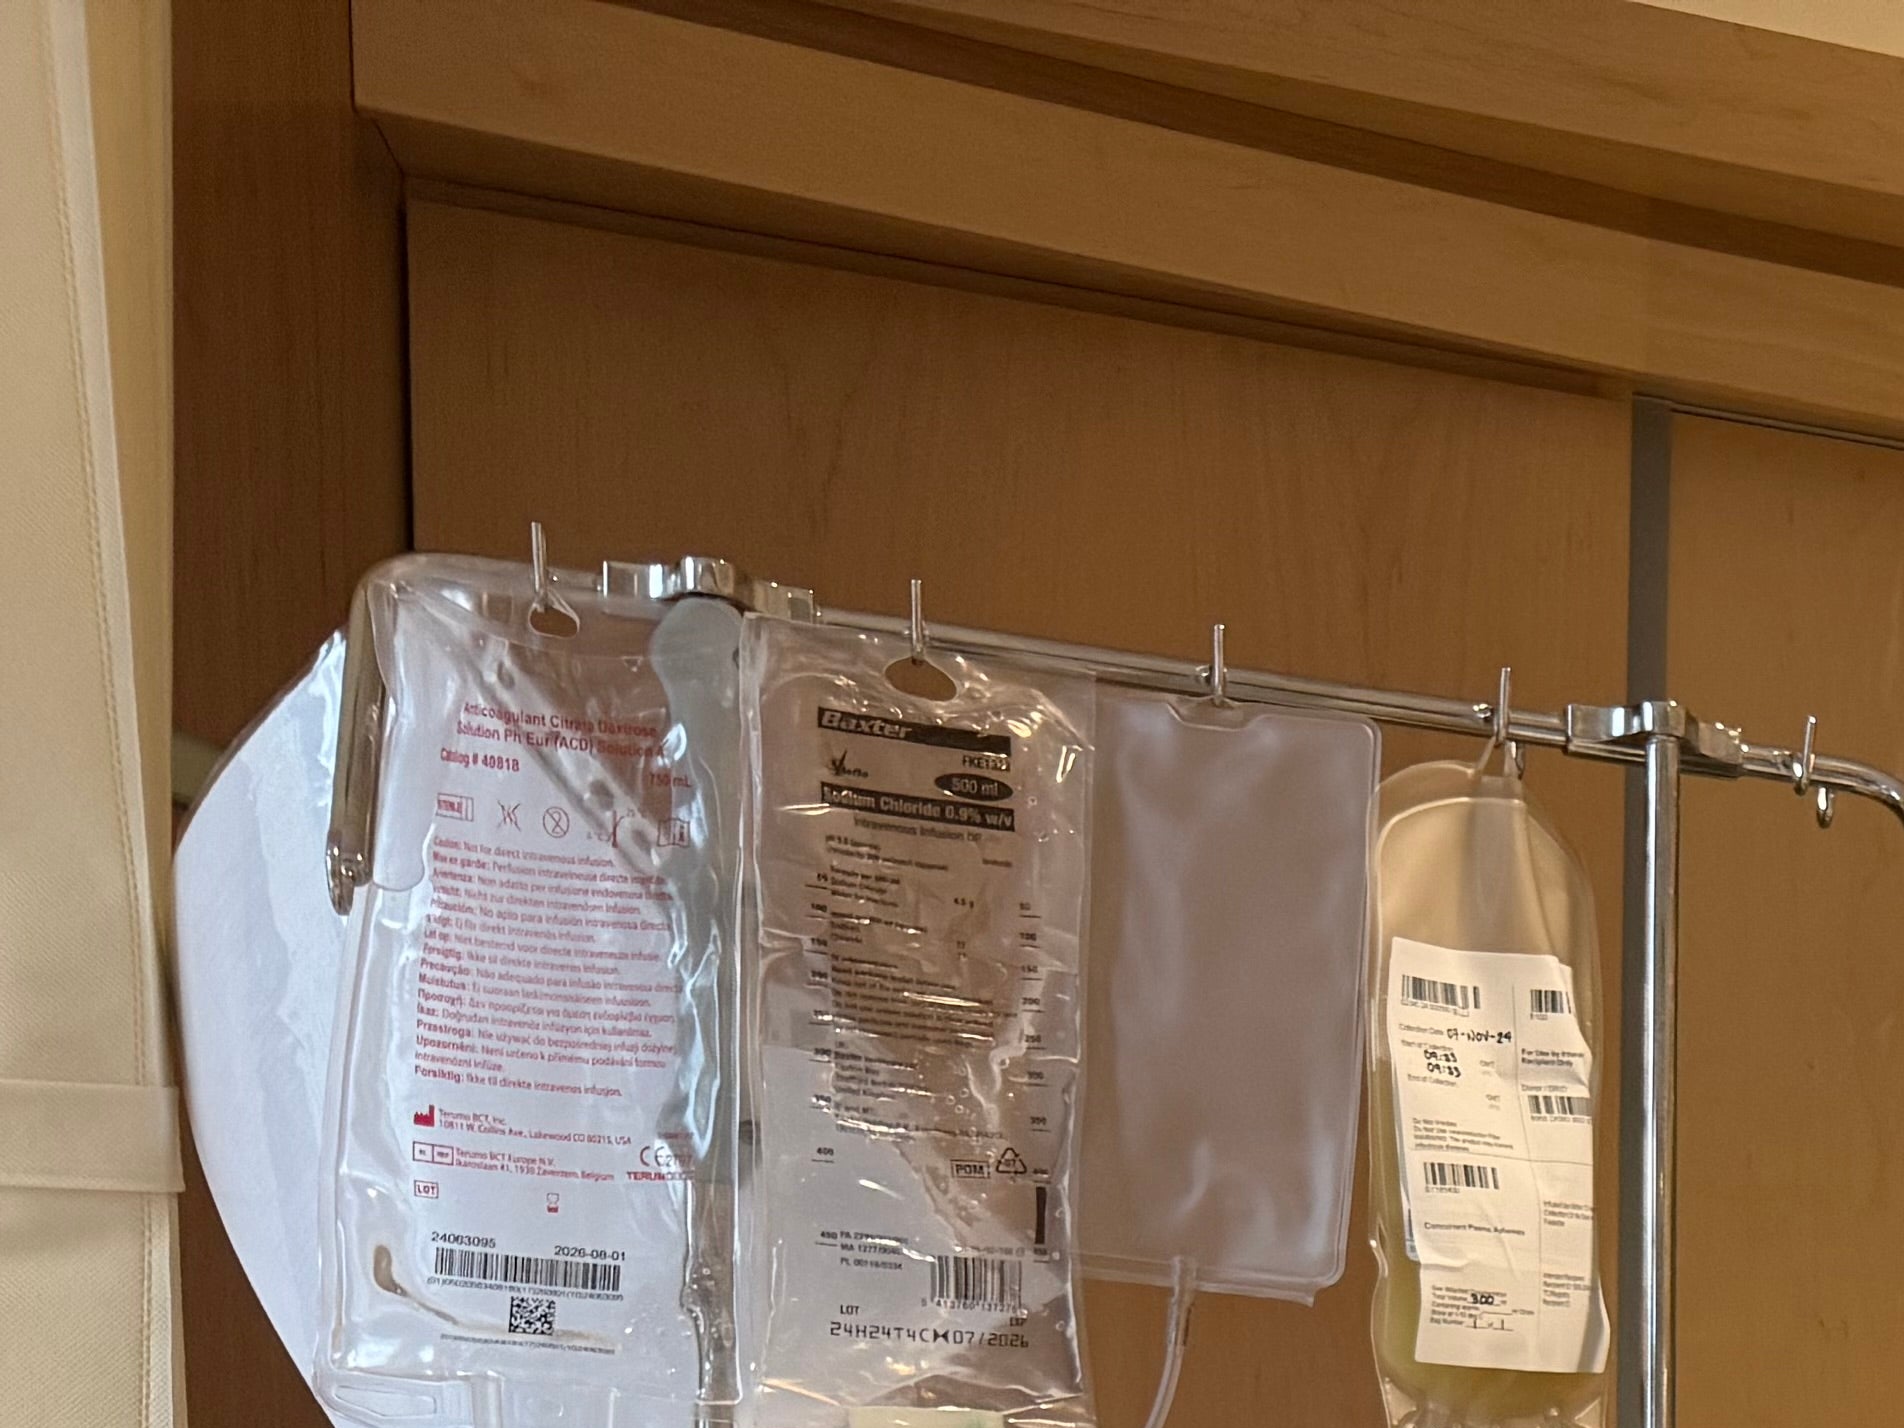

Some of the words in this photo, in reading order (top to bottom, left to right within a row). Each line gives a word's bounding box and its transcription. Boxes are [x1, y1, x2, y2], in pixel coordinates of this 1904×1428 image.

[822, 711, 912, 739] Baxter
[504, 727, 521, 745] Ph
[526, 731, 550, 748] Eur
[554, 732, 594, 754] (ACD)
[952, 778, 978, 795] 500
[981, 782, 998, 798] ml
[823, 786, 876, 809] Sodium
[880, 796, 940, 818] Chloride
[945, 805, 982, 825] 0.9%
[985, 812, 1013, 827] w/v
[439, 1108, 471, 1123] Terumo
[418, 1183, 436, 1196] LOT
[840, 1305, 859, 1316] LOT
[830, 1321, 930, 1343] 24H24T4C
[953, 1330, 1029, 1349] 07/2026
